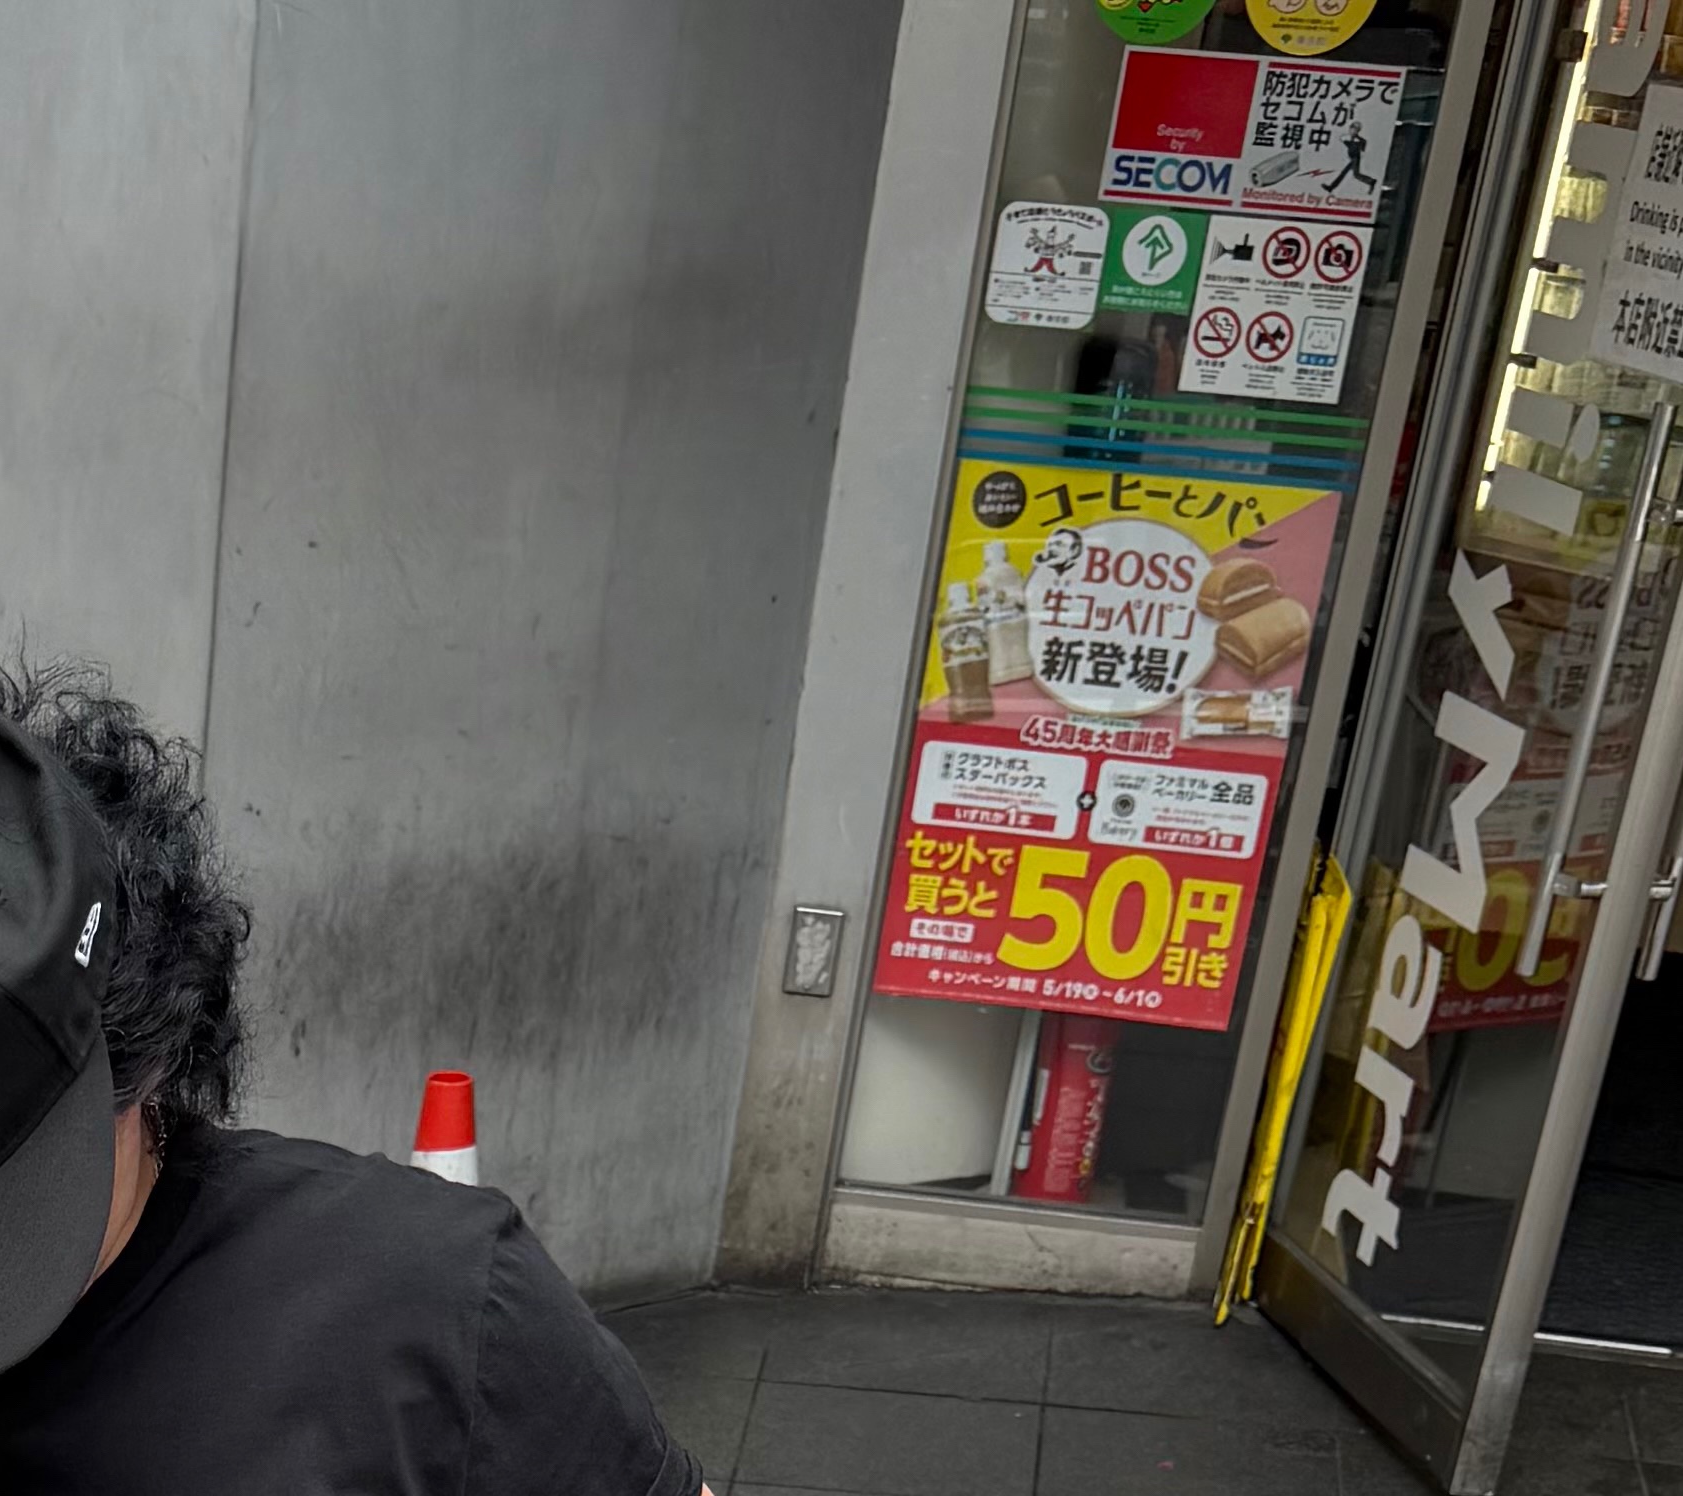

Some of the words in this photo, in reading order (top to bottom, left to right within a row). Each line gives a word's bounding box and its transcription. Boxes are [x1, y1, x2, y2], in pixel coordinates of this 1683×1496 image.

[1265, 71, 1399, 104] 防犯カメラで
[1260, 100, 1355, 126] セコムが
[1156, 123, 1205, 142] Security
[1252, 121, 1331, 152] 監視中
[1111, 155, 1234, 195] SECOM
[1241, 187, 1304, 203] Monitored
[1307, 192, 1323, 206] by
[1325, 194, 1373, 209] Camera
[1630, 201, 1667, 234] Drinking
[1633, 241, 1650, 266] the
[1034, 472, 1278, 549] コーヒーとパン
[1082, 546, 1196, 593] BOSS
[1039, 591, 1196, 641] 生コッペパン
[1041, 636, 1188, 693] 新登場!
[1209, 780, 1255, 805] 全品
[905, 830, 1014, 876] セットで
[904, 873, 999, 919] 買うと
